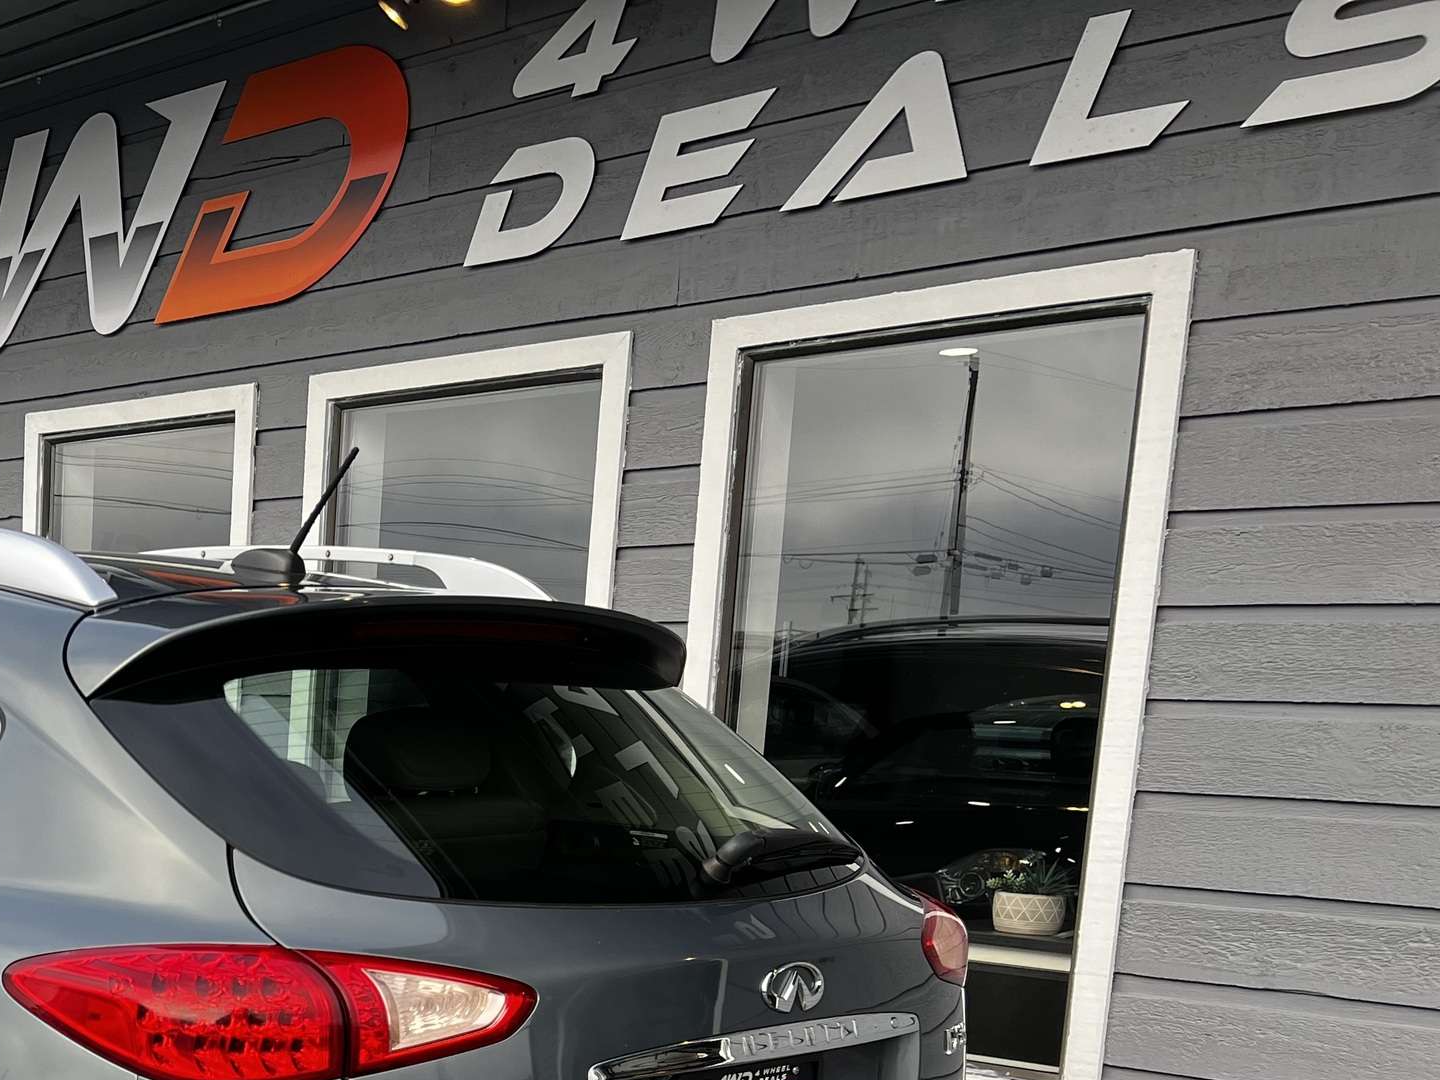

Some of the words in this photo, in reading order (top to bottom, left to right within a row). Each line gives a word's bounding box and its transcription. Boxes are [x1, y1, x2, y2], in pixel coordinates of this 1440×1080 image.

[512, 0, 638, 98] 4
[462, 0, 1440, 267] DEALS
[754, 1069, 761, 1077] 4
[763, 1064, 791, 1075] WHEEL
